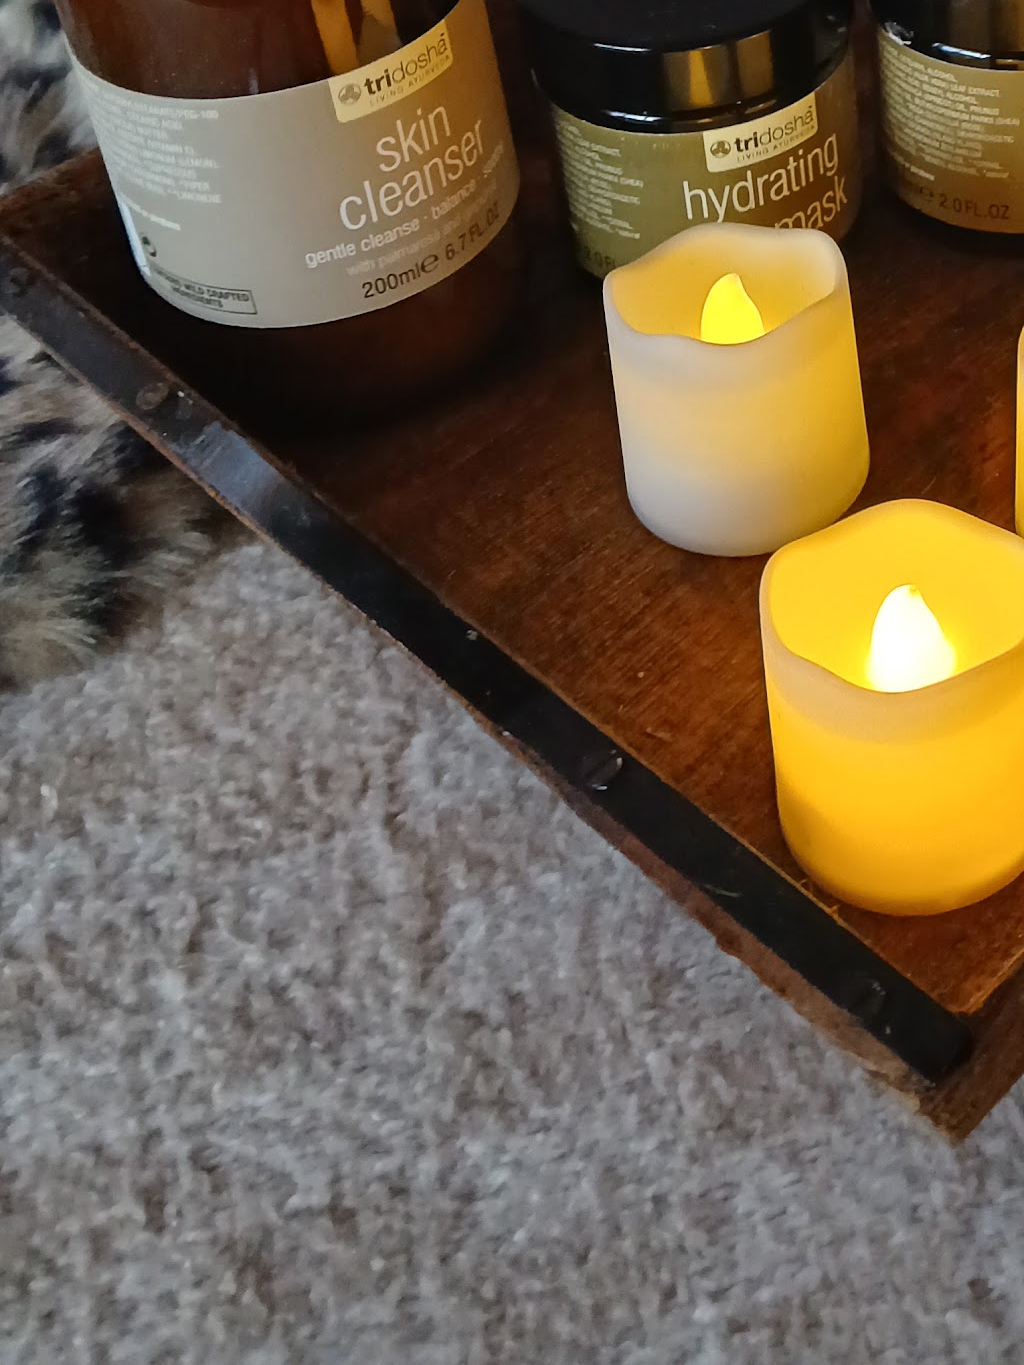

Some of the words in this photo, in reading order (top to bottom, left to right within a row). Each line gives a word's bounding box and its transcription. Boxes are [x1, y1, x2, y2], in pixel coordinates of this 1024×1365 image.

[363, 37, 448, 95] tridosha
[376, 106, 450, 172] skin
[734, 108, 814, 153] tridosha
[737, 149, 769, 163] LIVING
[339, 119, 483, 231] cleanser
[683, 133, 838, 223] hydrating
[774, 175, 847, 229] mask
[305, 242, 357, 269] gentle
[361, 218, 420, 252] cleanse
